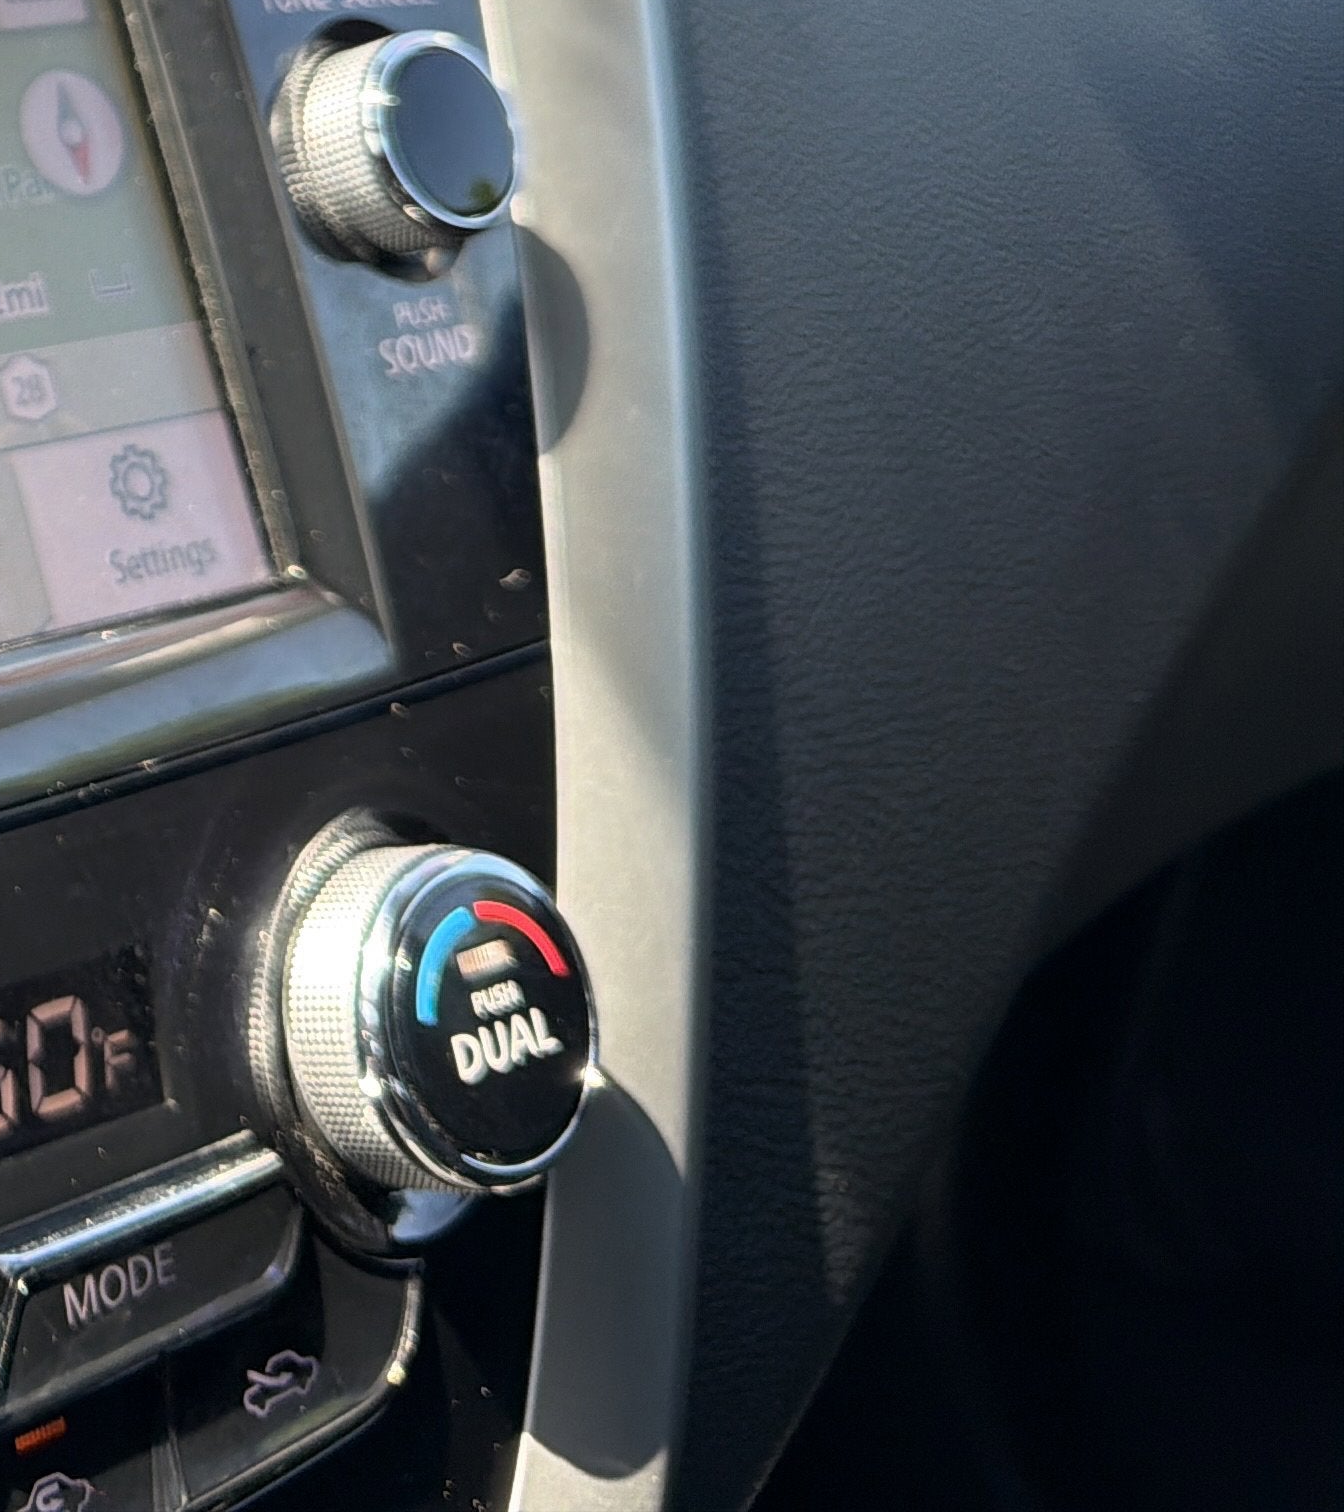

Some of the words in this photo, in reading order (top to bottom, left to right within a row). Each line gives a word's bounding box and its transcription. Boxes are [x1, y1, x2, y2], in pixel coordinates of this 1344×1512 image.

[378, 324, 478, 375] SOUND
[109, 537, 217, 589] Settings
[471, 980, 525, 1018] PUSH
[451, 1008, 564, 1085] DUAL
[64, 1244, 177, 1331] MODE
